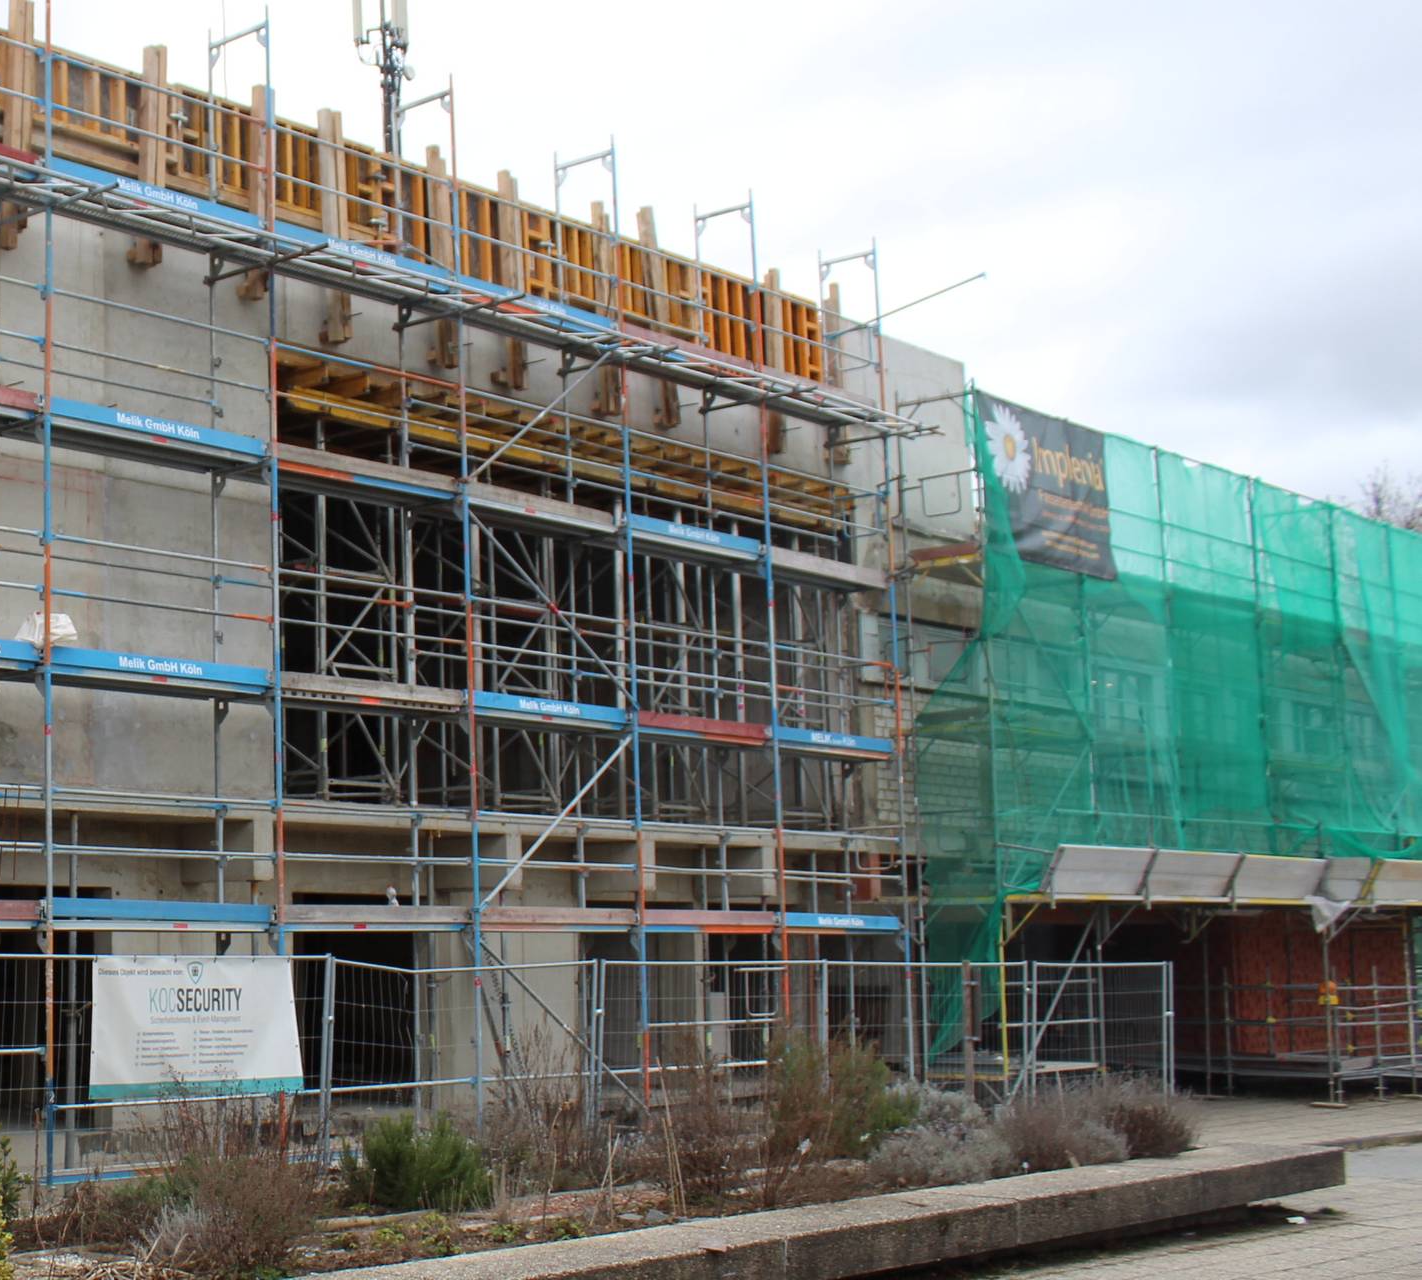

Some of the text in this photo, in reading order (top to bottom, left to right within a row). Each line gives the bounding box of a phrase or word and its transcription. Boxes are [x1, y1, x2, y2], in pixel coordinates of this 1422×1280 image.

[116, 178, 198, 210] Melik GmbH Köln
[116, 412, 200, 440] Melik GmbH Köln
[1031, 436, 1105, 491] Implenia
[119, 656, 202, 675] Melik GmbH Köln
[540, 702, 562, 713] GmbH
[137, 968, 149, 976] wird
